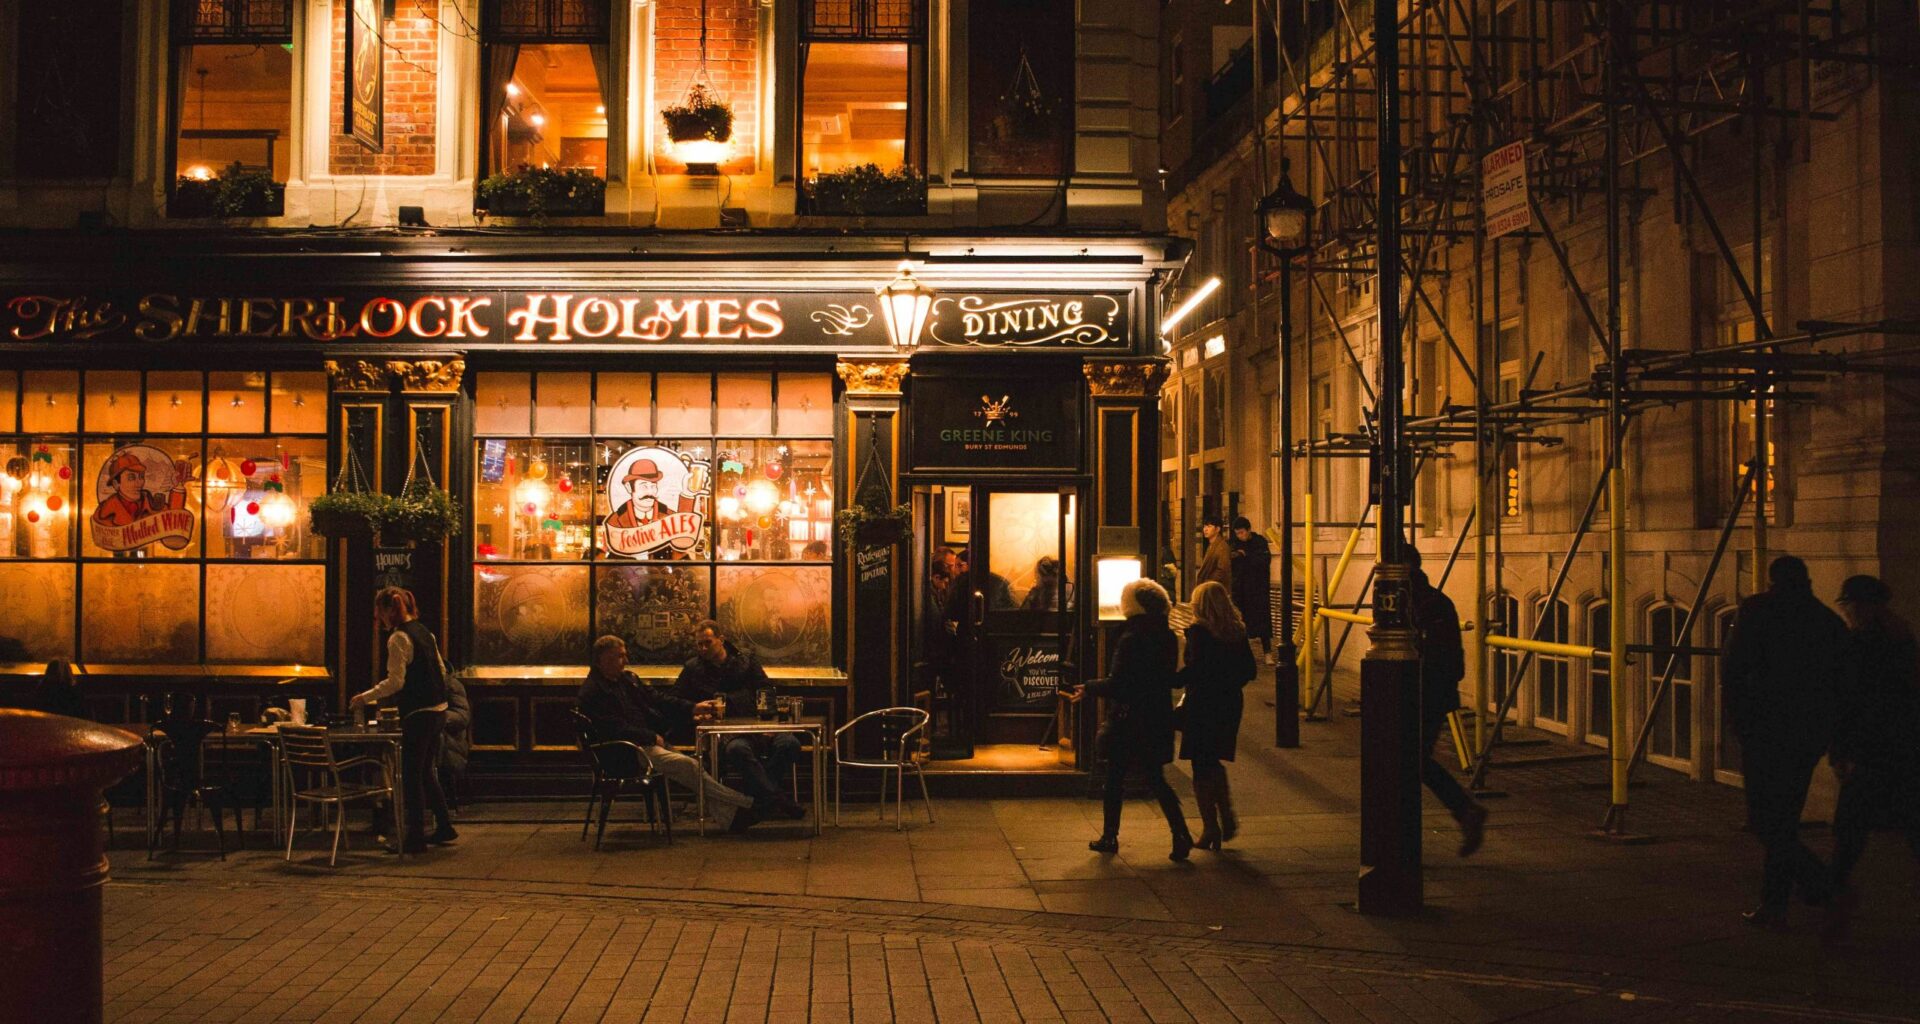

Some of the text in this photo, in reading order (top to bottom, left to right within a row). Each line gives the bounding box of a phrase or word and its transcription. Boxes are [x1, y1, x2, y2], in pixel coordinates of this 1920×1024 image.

[7, 293, 784, 341] The SHERLOCK HOLMES
[962, 301, 1083, 336] DINING
[940, 429, 1053, 443] GREENE KING
[122, 516, 159, 546] Mulled
[161, 511, 190, 532] WINE
[660, 514, 696, 540] ALES
[376, 552, 412, 571] HOUNDS
[1006, 647, 1059, 672] Welcom
